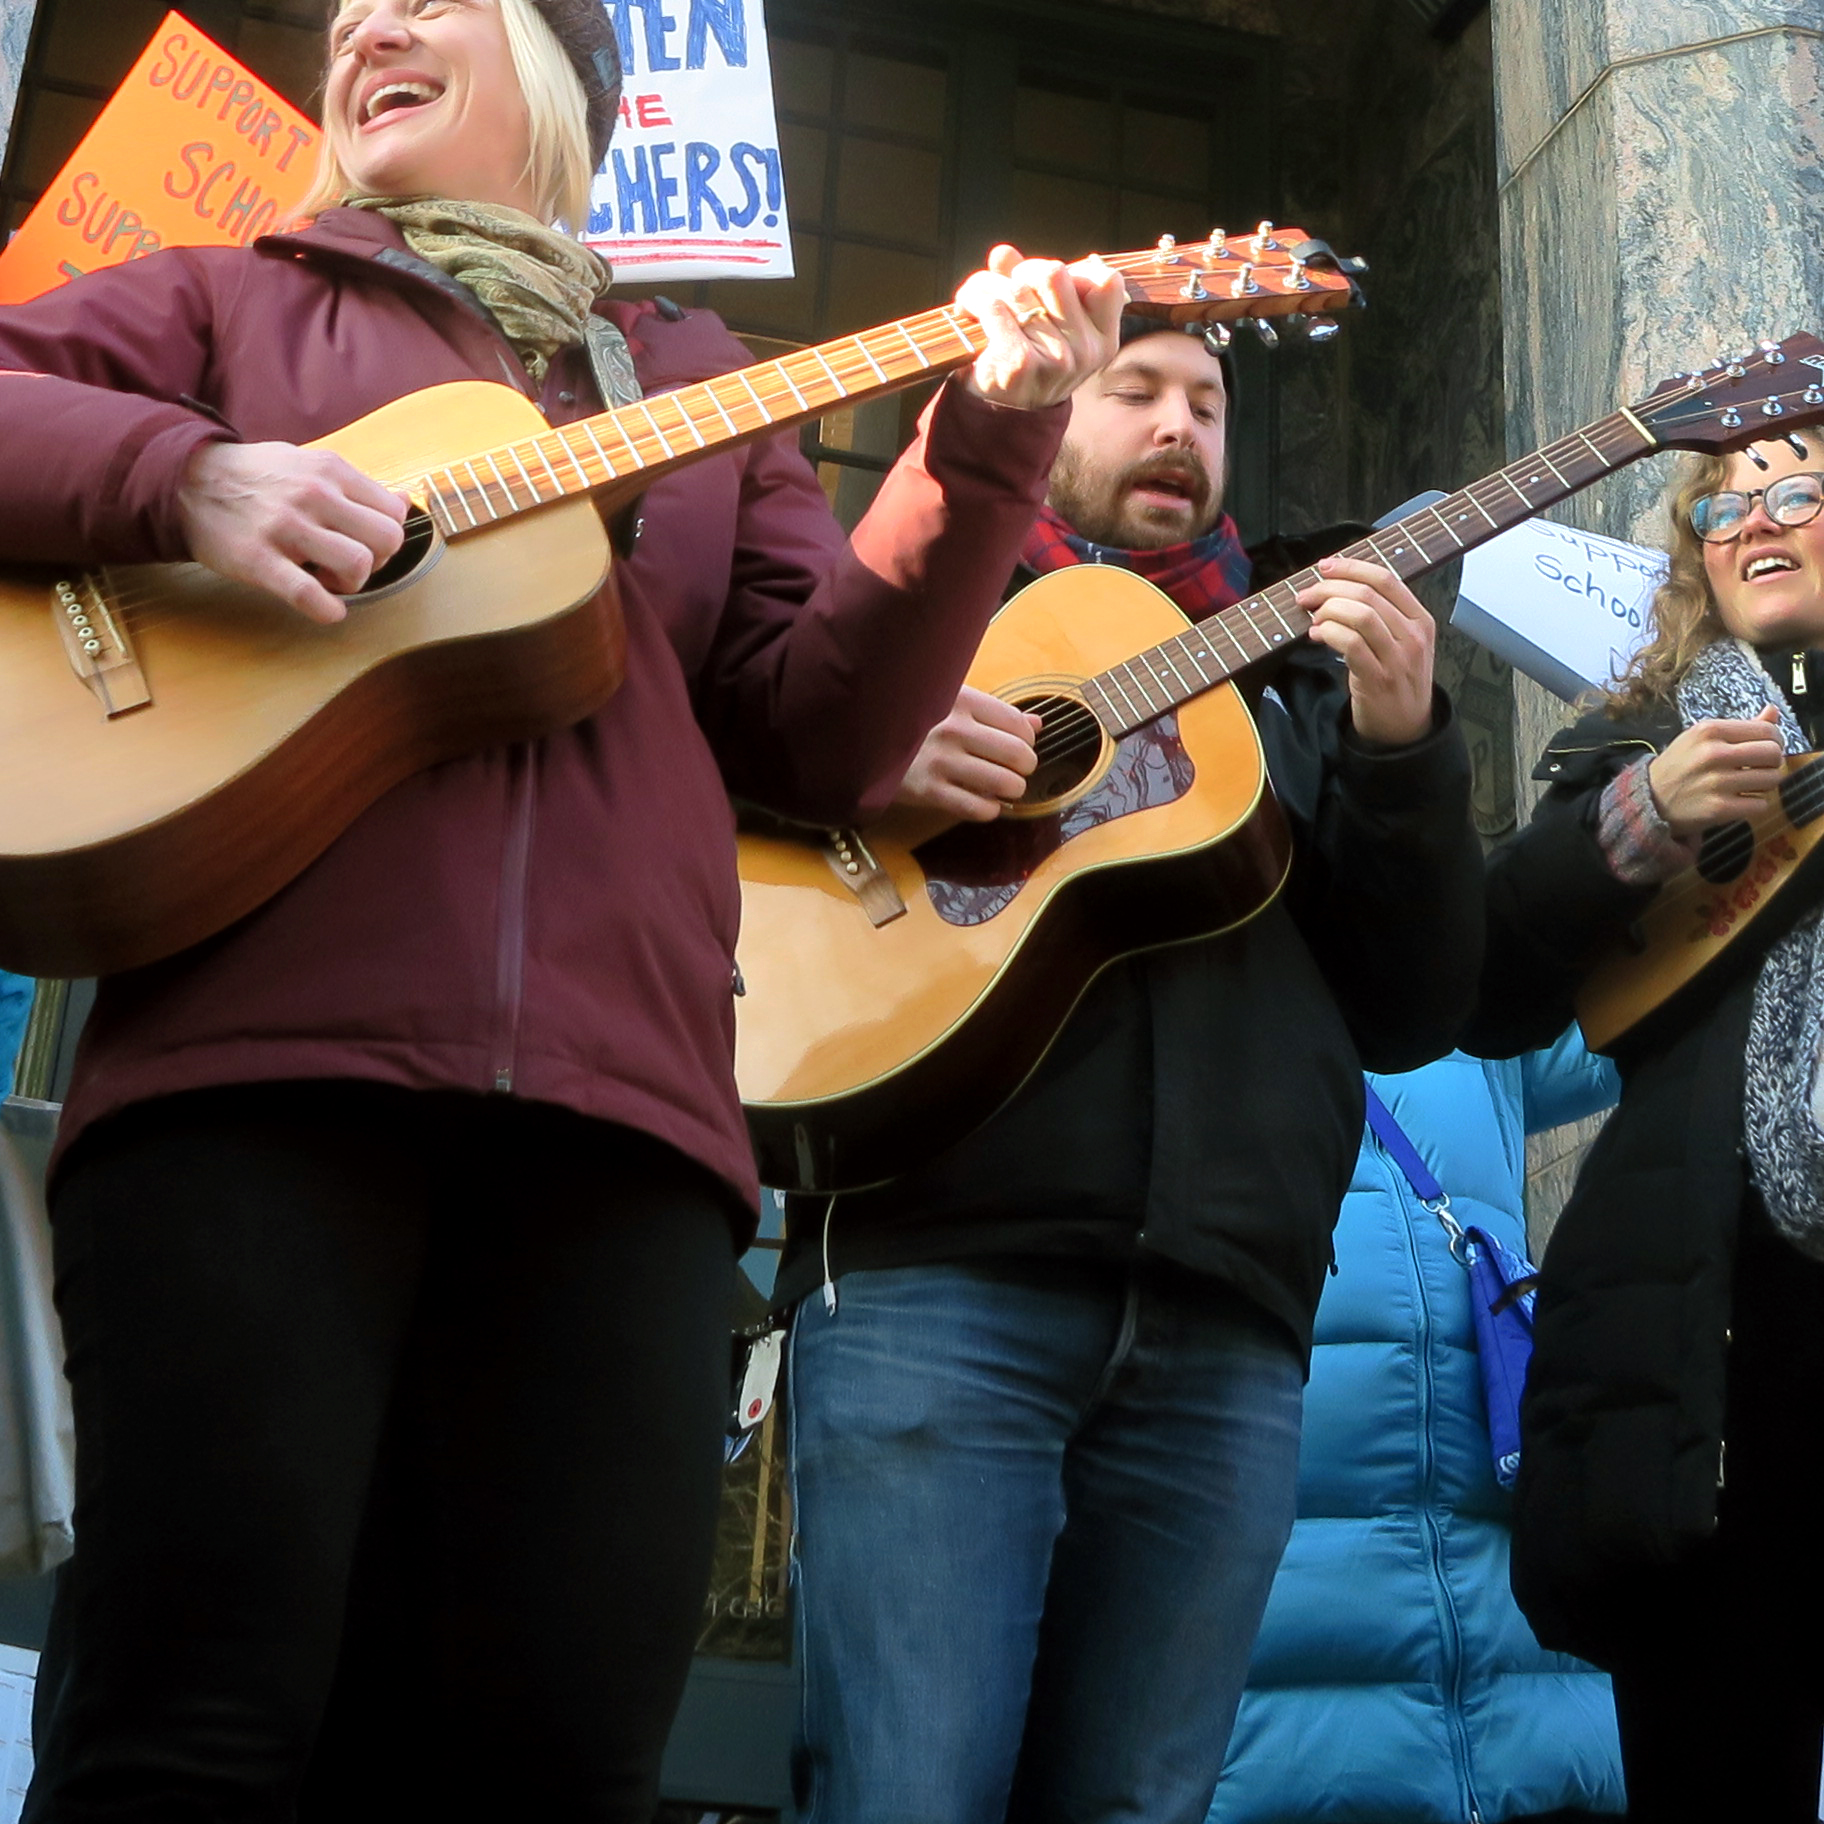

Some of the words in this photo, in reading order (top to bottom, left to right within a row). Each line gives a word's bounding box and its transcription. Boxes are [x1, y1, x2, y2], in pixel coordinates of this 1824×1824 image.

[149, 34, 313, 173] SUPPORT
[57, 172, 162, 260] SUPP
[164, 141, 276, 248] SCHO
[582, 140, 781, 237] CHERS!
[1534, 553, 1642, 628] Schoo
